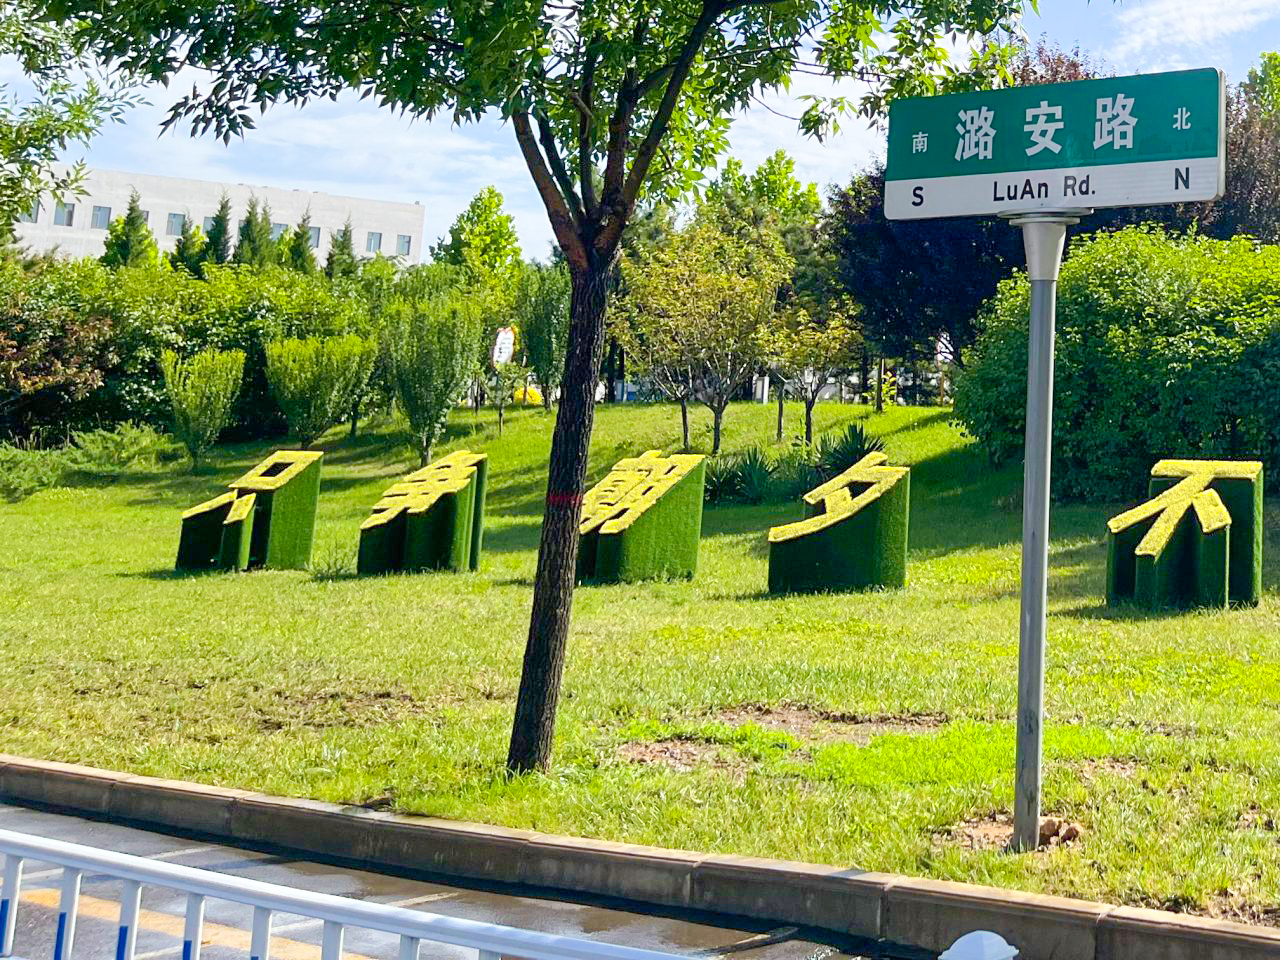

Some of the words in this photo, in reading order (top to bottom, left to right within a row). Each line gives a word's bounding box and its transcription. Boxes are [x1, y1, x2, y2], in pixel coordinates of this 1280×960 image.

[954, 93, 1138, 161] 潞安路
[1172, 106, 1192, 131] 北
[912, 131, 929, 153] 南
[993, 179, 1049, 201] LuAn
[1063, 174, 1096, 197] Rd.
[1174, 166, 1190, 190] N
[912, 186, 924, 207] S
[768, 451, 910, 543] 夕
[1107, 459, 1262, 556] 不
